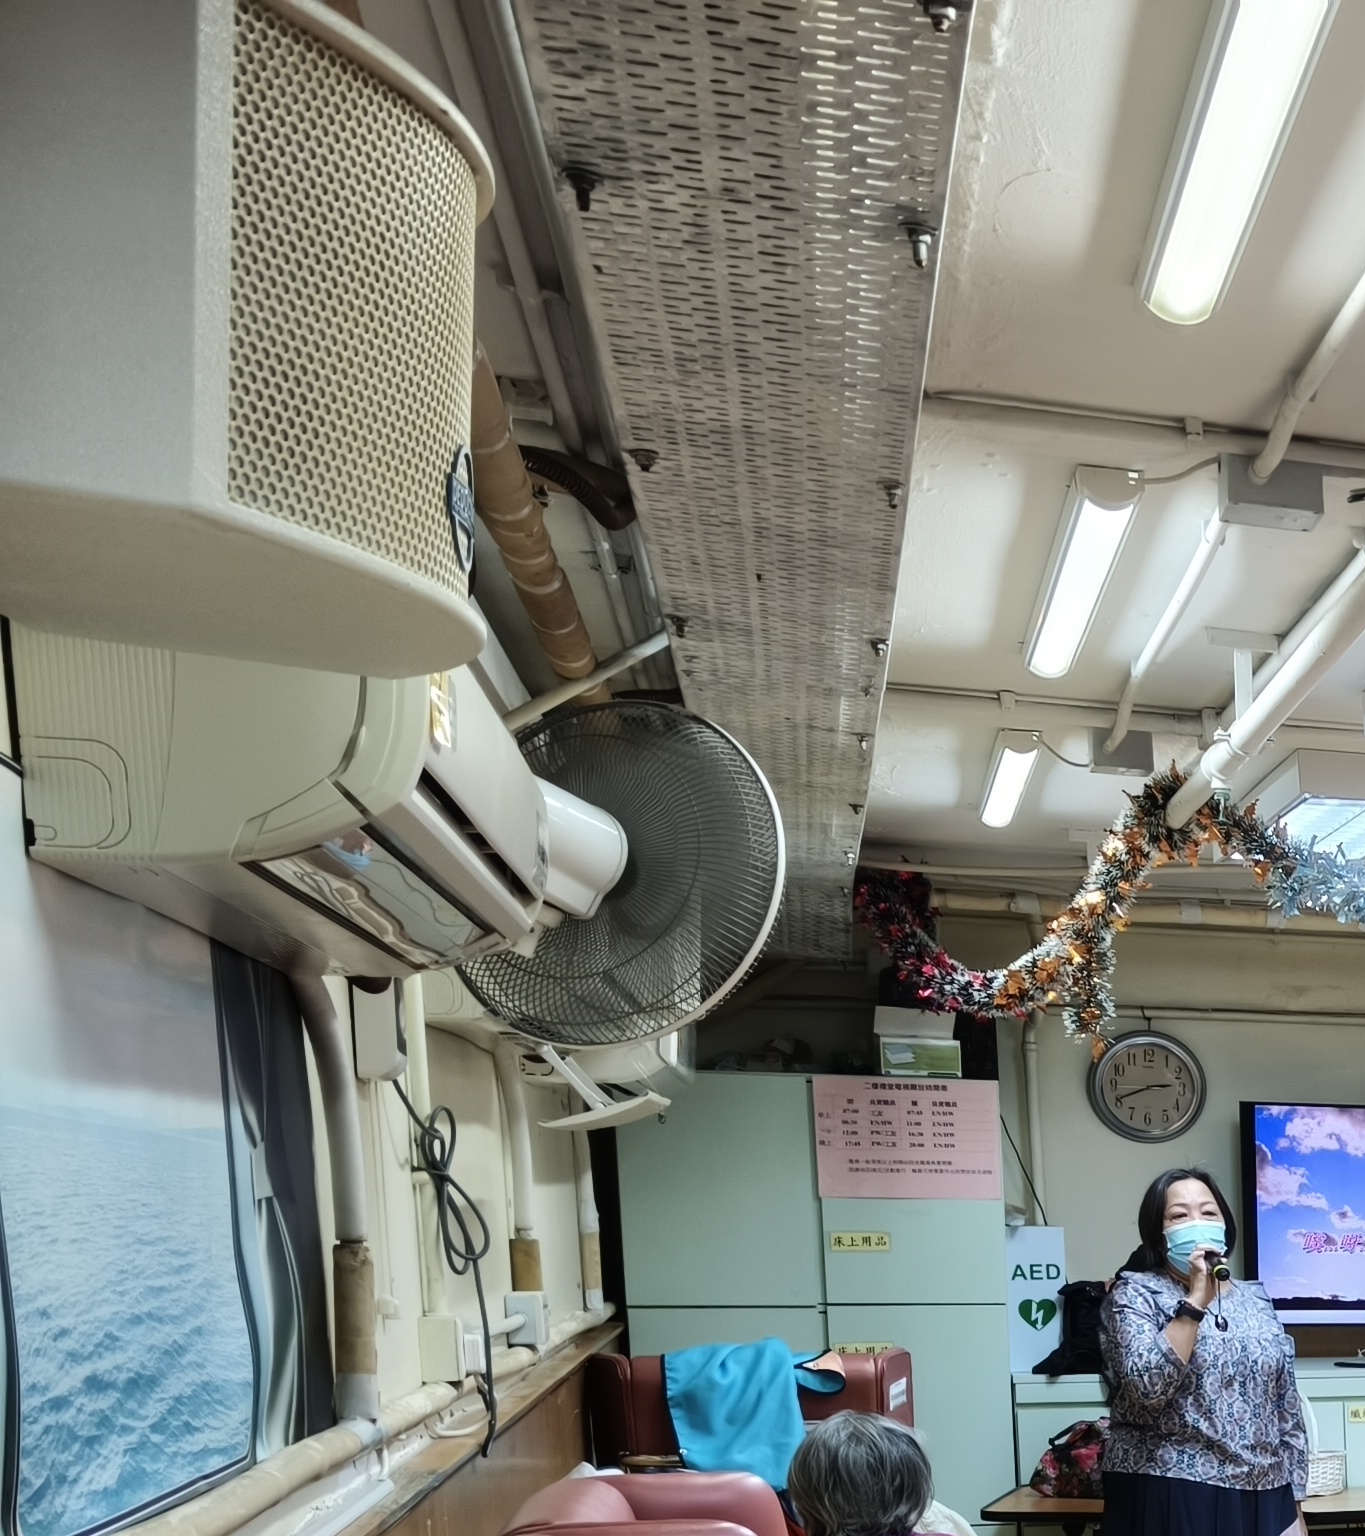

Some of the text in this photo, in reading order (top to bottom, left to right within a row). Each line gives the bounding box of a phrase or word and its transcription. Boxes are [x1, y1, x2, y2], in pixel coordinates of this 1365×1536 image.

[1127, 1052, 1136, 1066] 11
[1143, 1048, 1155, 1062] 12
[1165, 1054, 1169, 1068] 1
[1114, 1063, 1125, 1077] 10
[1174, 1066, 1182, 1080] 2
[1110, 1078, 1118, 1092] 9
[1178, 1082, 1186, 1096] 3
[1115, 1094, 1123, 1108] 8
[1173, 1098, 1180, 1112] 4
[1128, 1107, 1135, 1120] 7
[1144, 1112, 1151, 1126] 6
[1162, 1109, 1169, 1123] 5
[833, 1236, 887, 1247] 床上用品
[1011, 1263, 1061, 1280] AED
